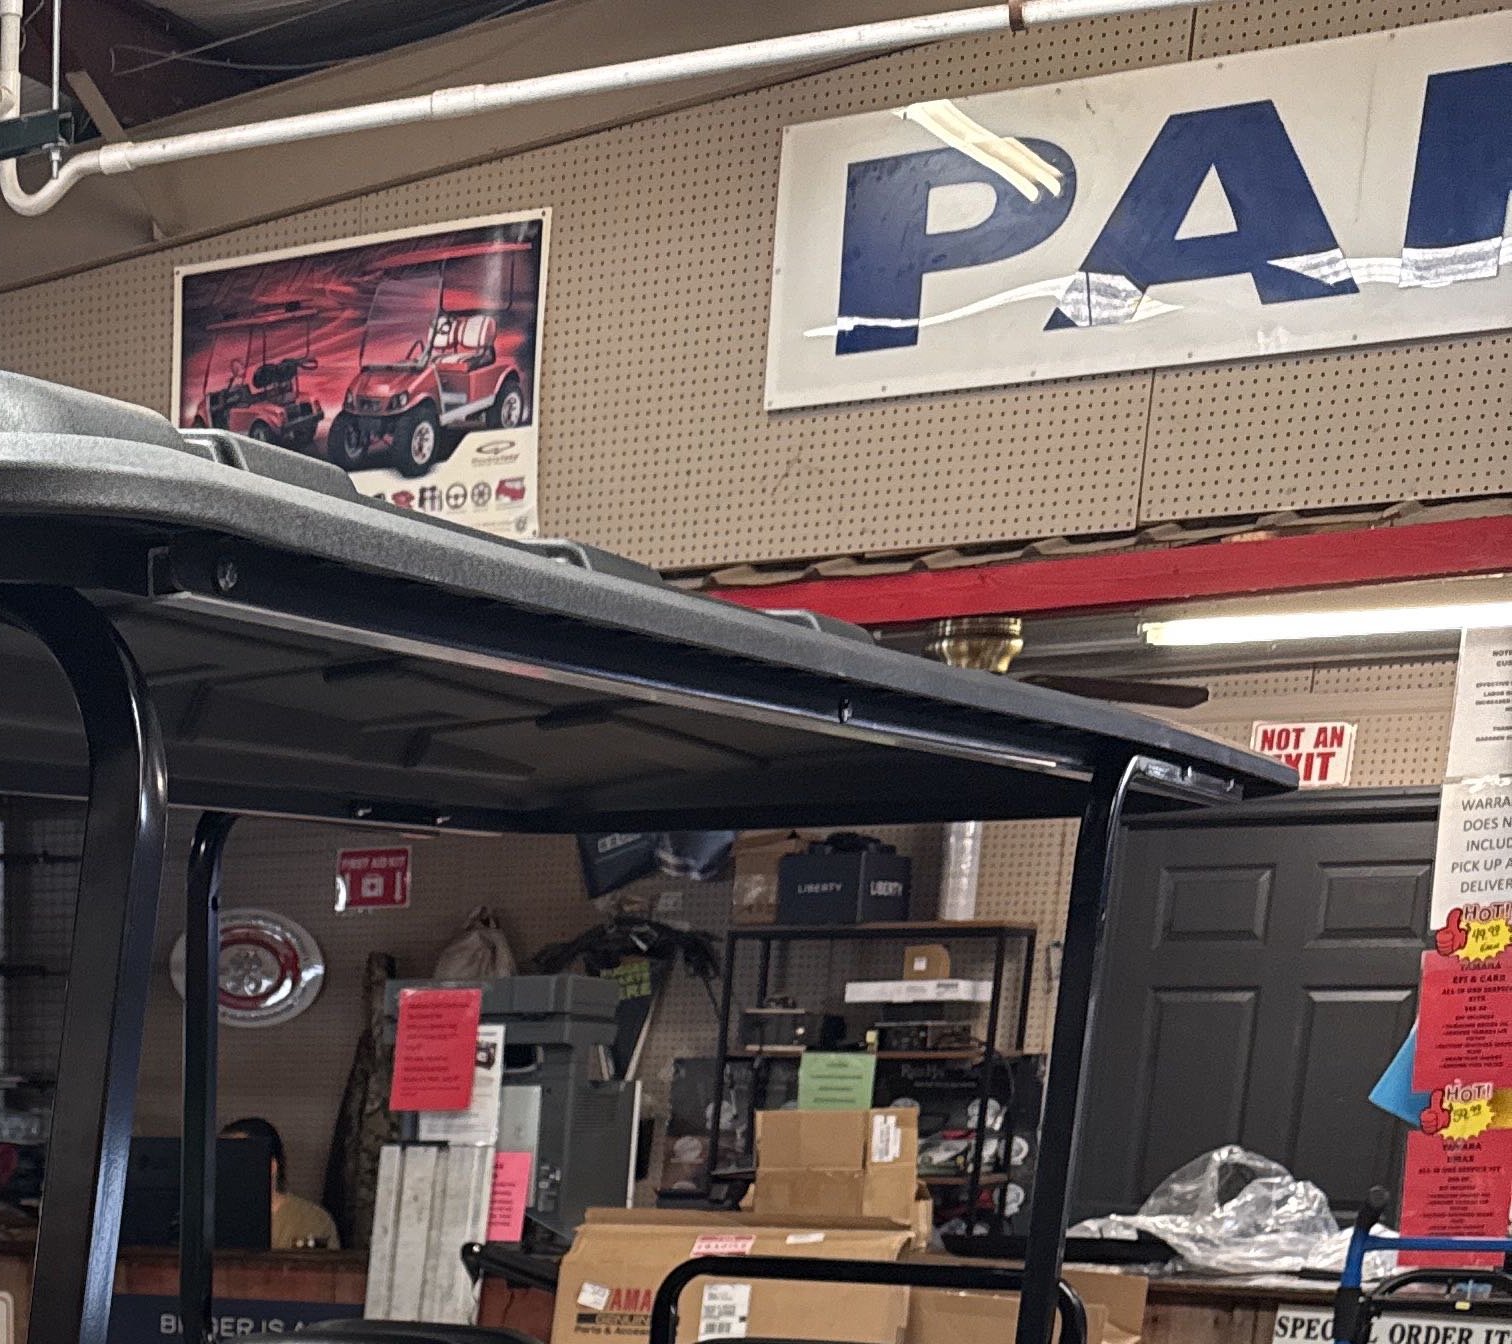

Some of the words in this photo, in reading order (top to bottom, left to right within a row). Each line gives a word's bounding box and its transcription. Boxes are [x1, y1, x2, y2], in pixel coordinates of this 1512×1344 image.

[1260, 728, 1305, 751] NOT
[1313, 726, 1344, 749] AN
[1273, 752, 1336, 781] XIT
[1463, 818, 1498, 832] DOES
[1451, 861, 1480, 873] PICK
[1484, 858, 1502, 871] UP
[159, 1313, 254, 1338] BIER
[1275, 1316, 1378, 1344] SPECL
